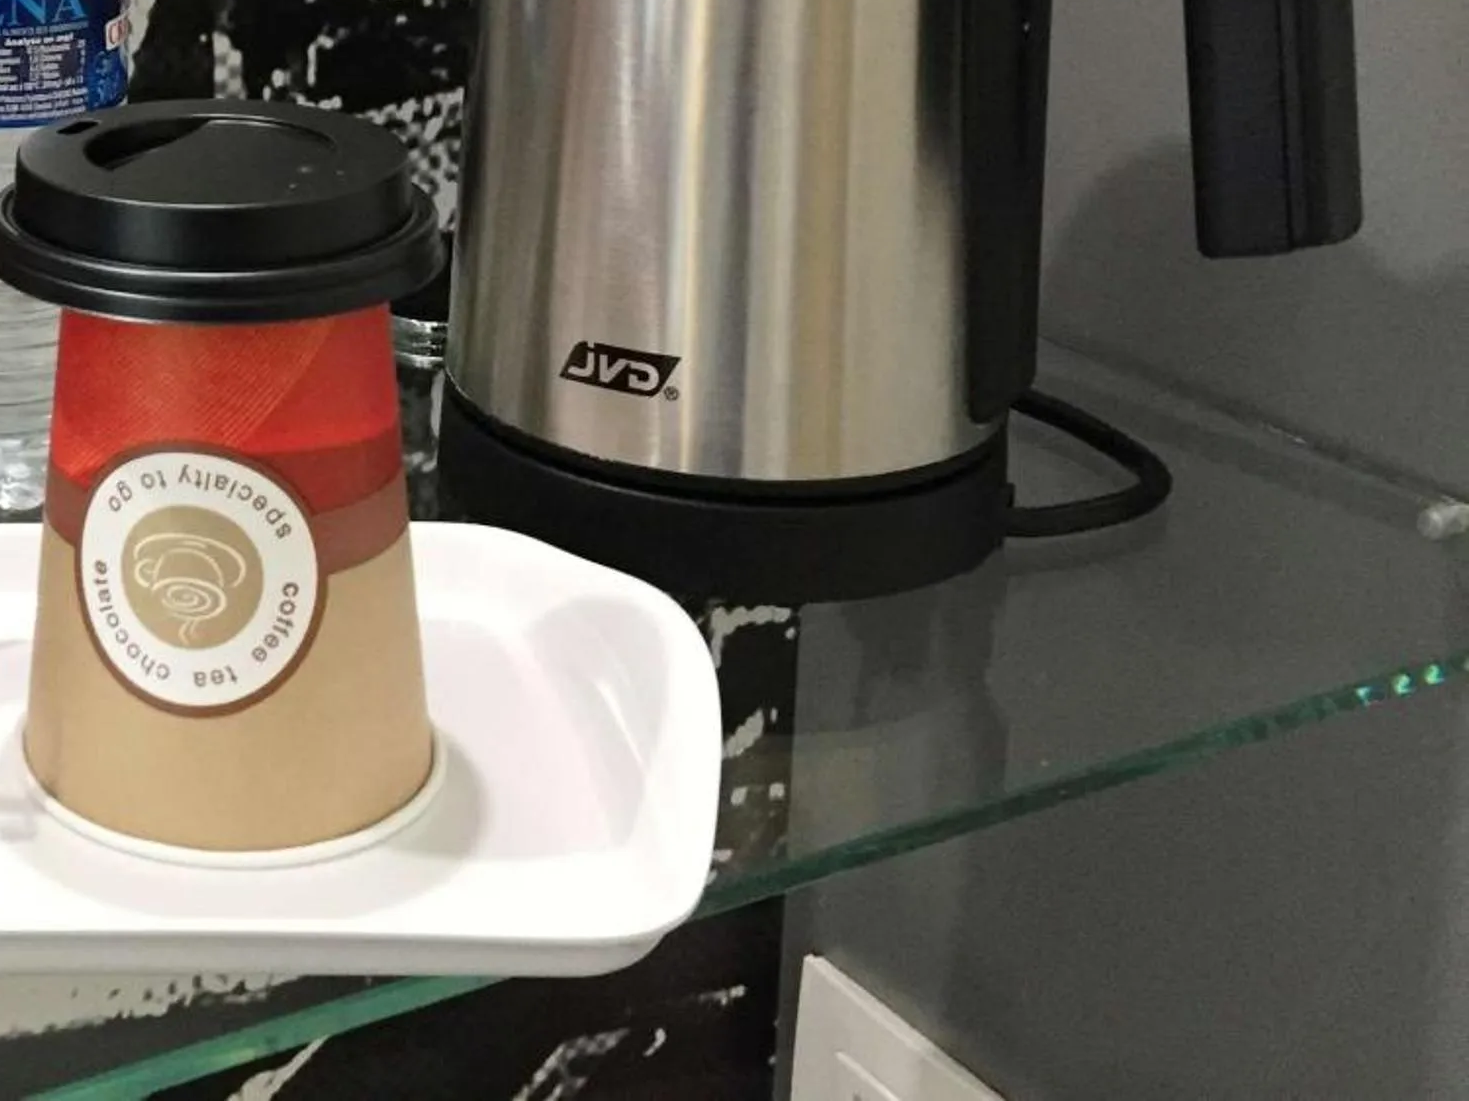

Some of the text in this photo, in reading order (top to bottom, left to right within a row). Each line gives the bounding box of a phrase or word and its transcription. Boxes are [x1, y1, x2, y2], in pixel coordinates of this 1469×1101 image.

[567, 341, 659, 391] JVD
[108, 464, 293, 539] specialty to go
[94, 559, 300, 688] coffee tea chocolate
